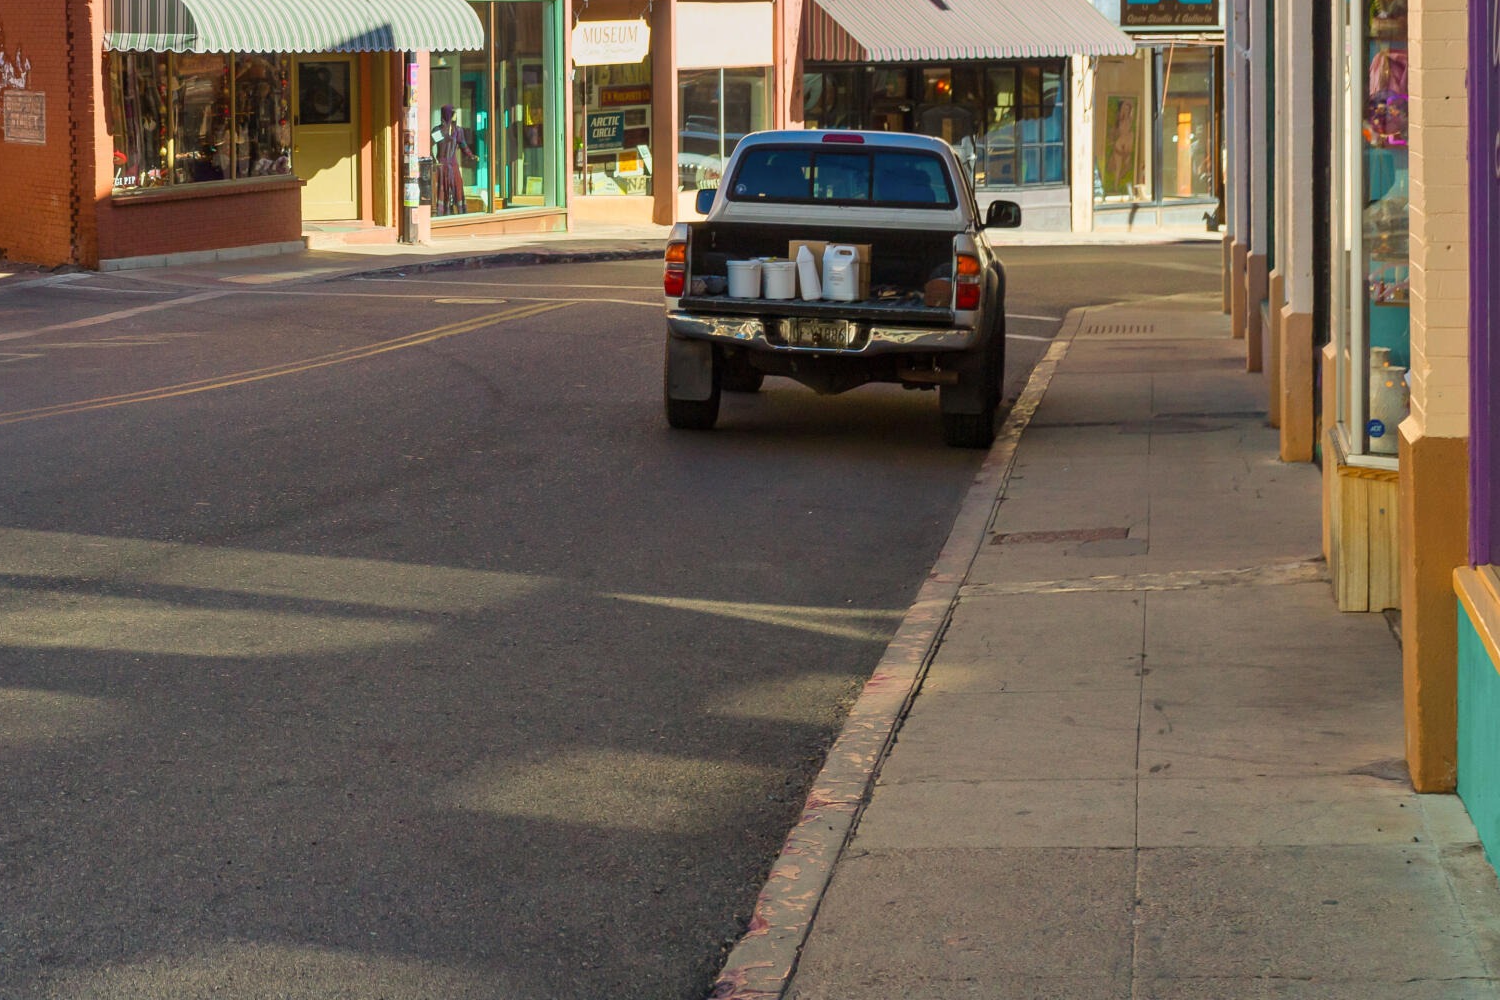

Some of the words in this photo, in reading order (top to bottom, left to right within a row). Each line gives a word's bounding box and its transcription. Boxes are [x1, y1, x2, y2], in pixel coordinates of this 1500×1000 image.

[582, 25, 639, 45] MUSEUM
[590, 115, 620, 128] ARCTIC
[592, 126, 617, 139] CIRCLE
